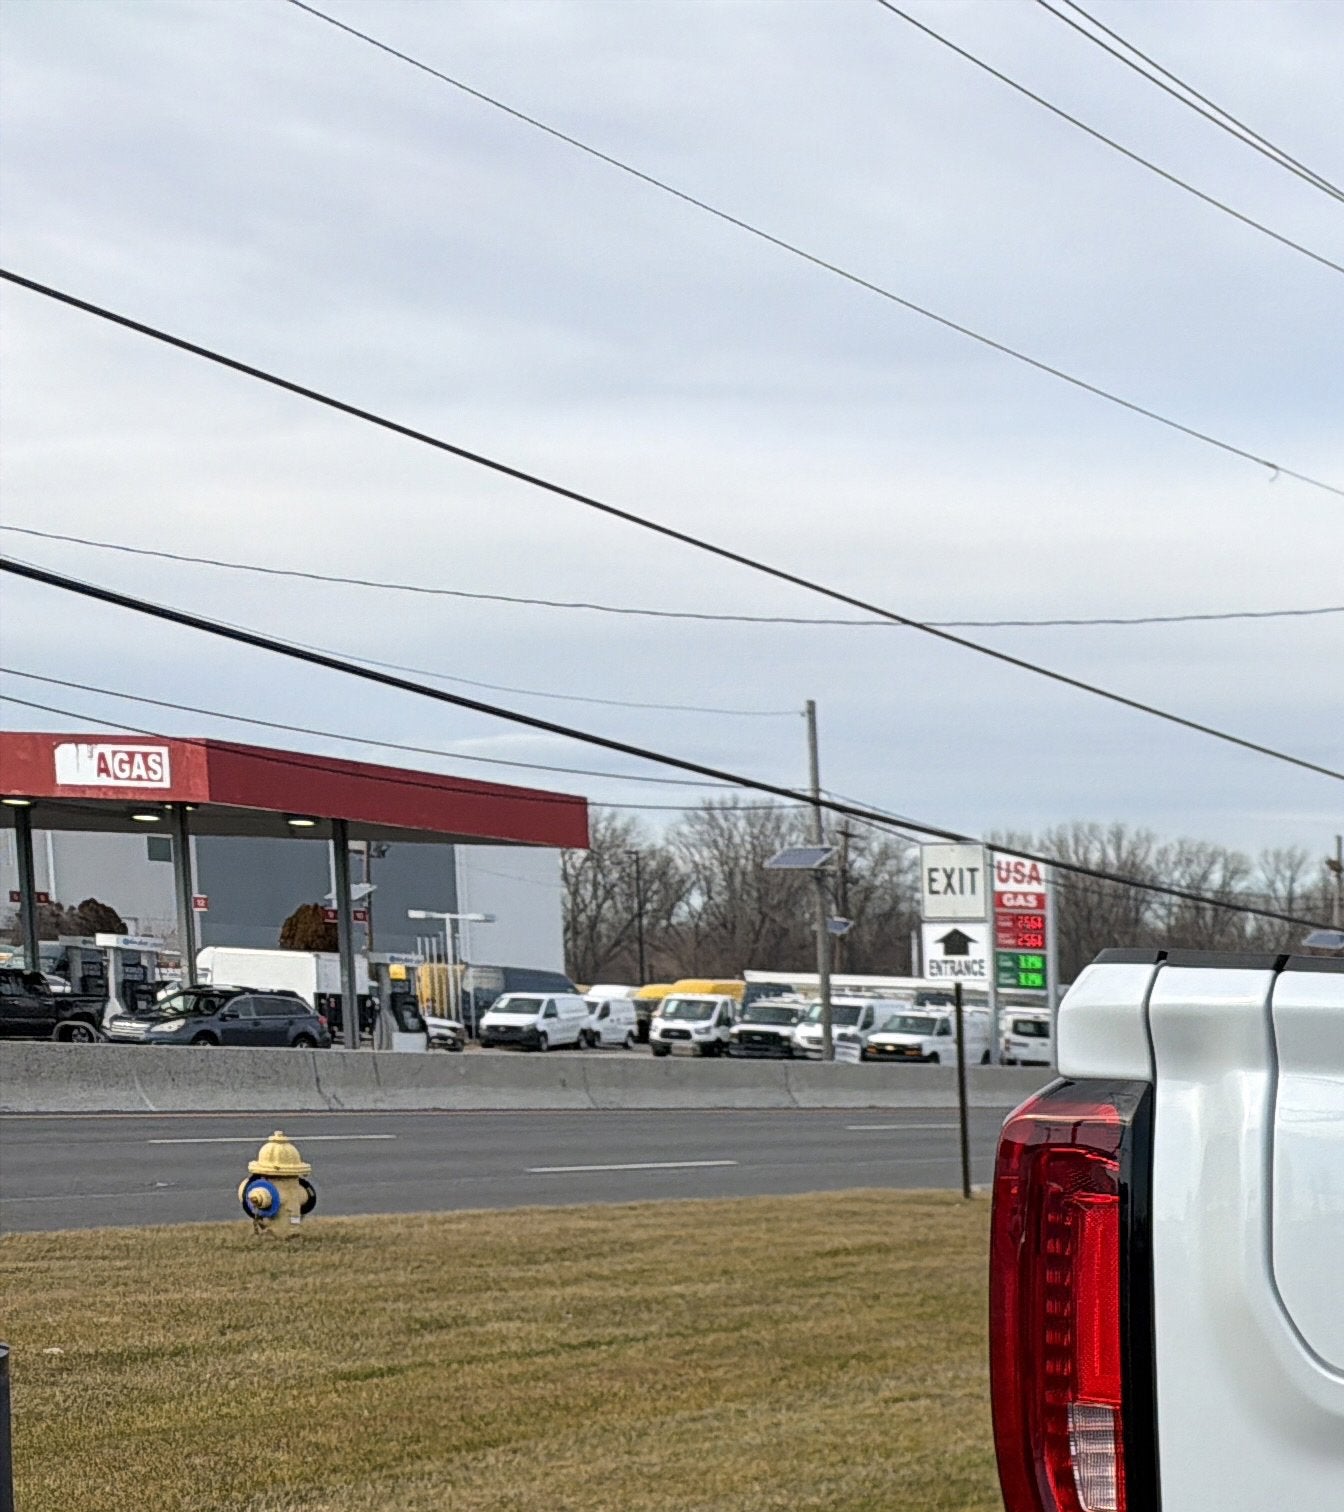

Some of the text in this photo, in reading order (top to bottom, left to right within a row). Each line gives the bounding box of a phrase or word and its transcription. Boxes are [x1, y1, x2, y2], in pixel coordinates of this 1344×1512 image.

[927, 867, 980, 896] EXIT
[996, 860, 1043, 886] USA
[1001, 892, 1038, 908] GAS
[928, 958, 986, 977] ENTRANCE
